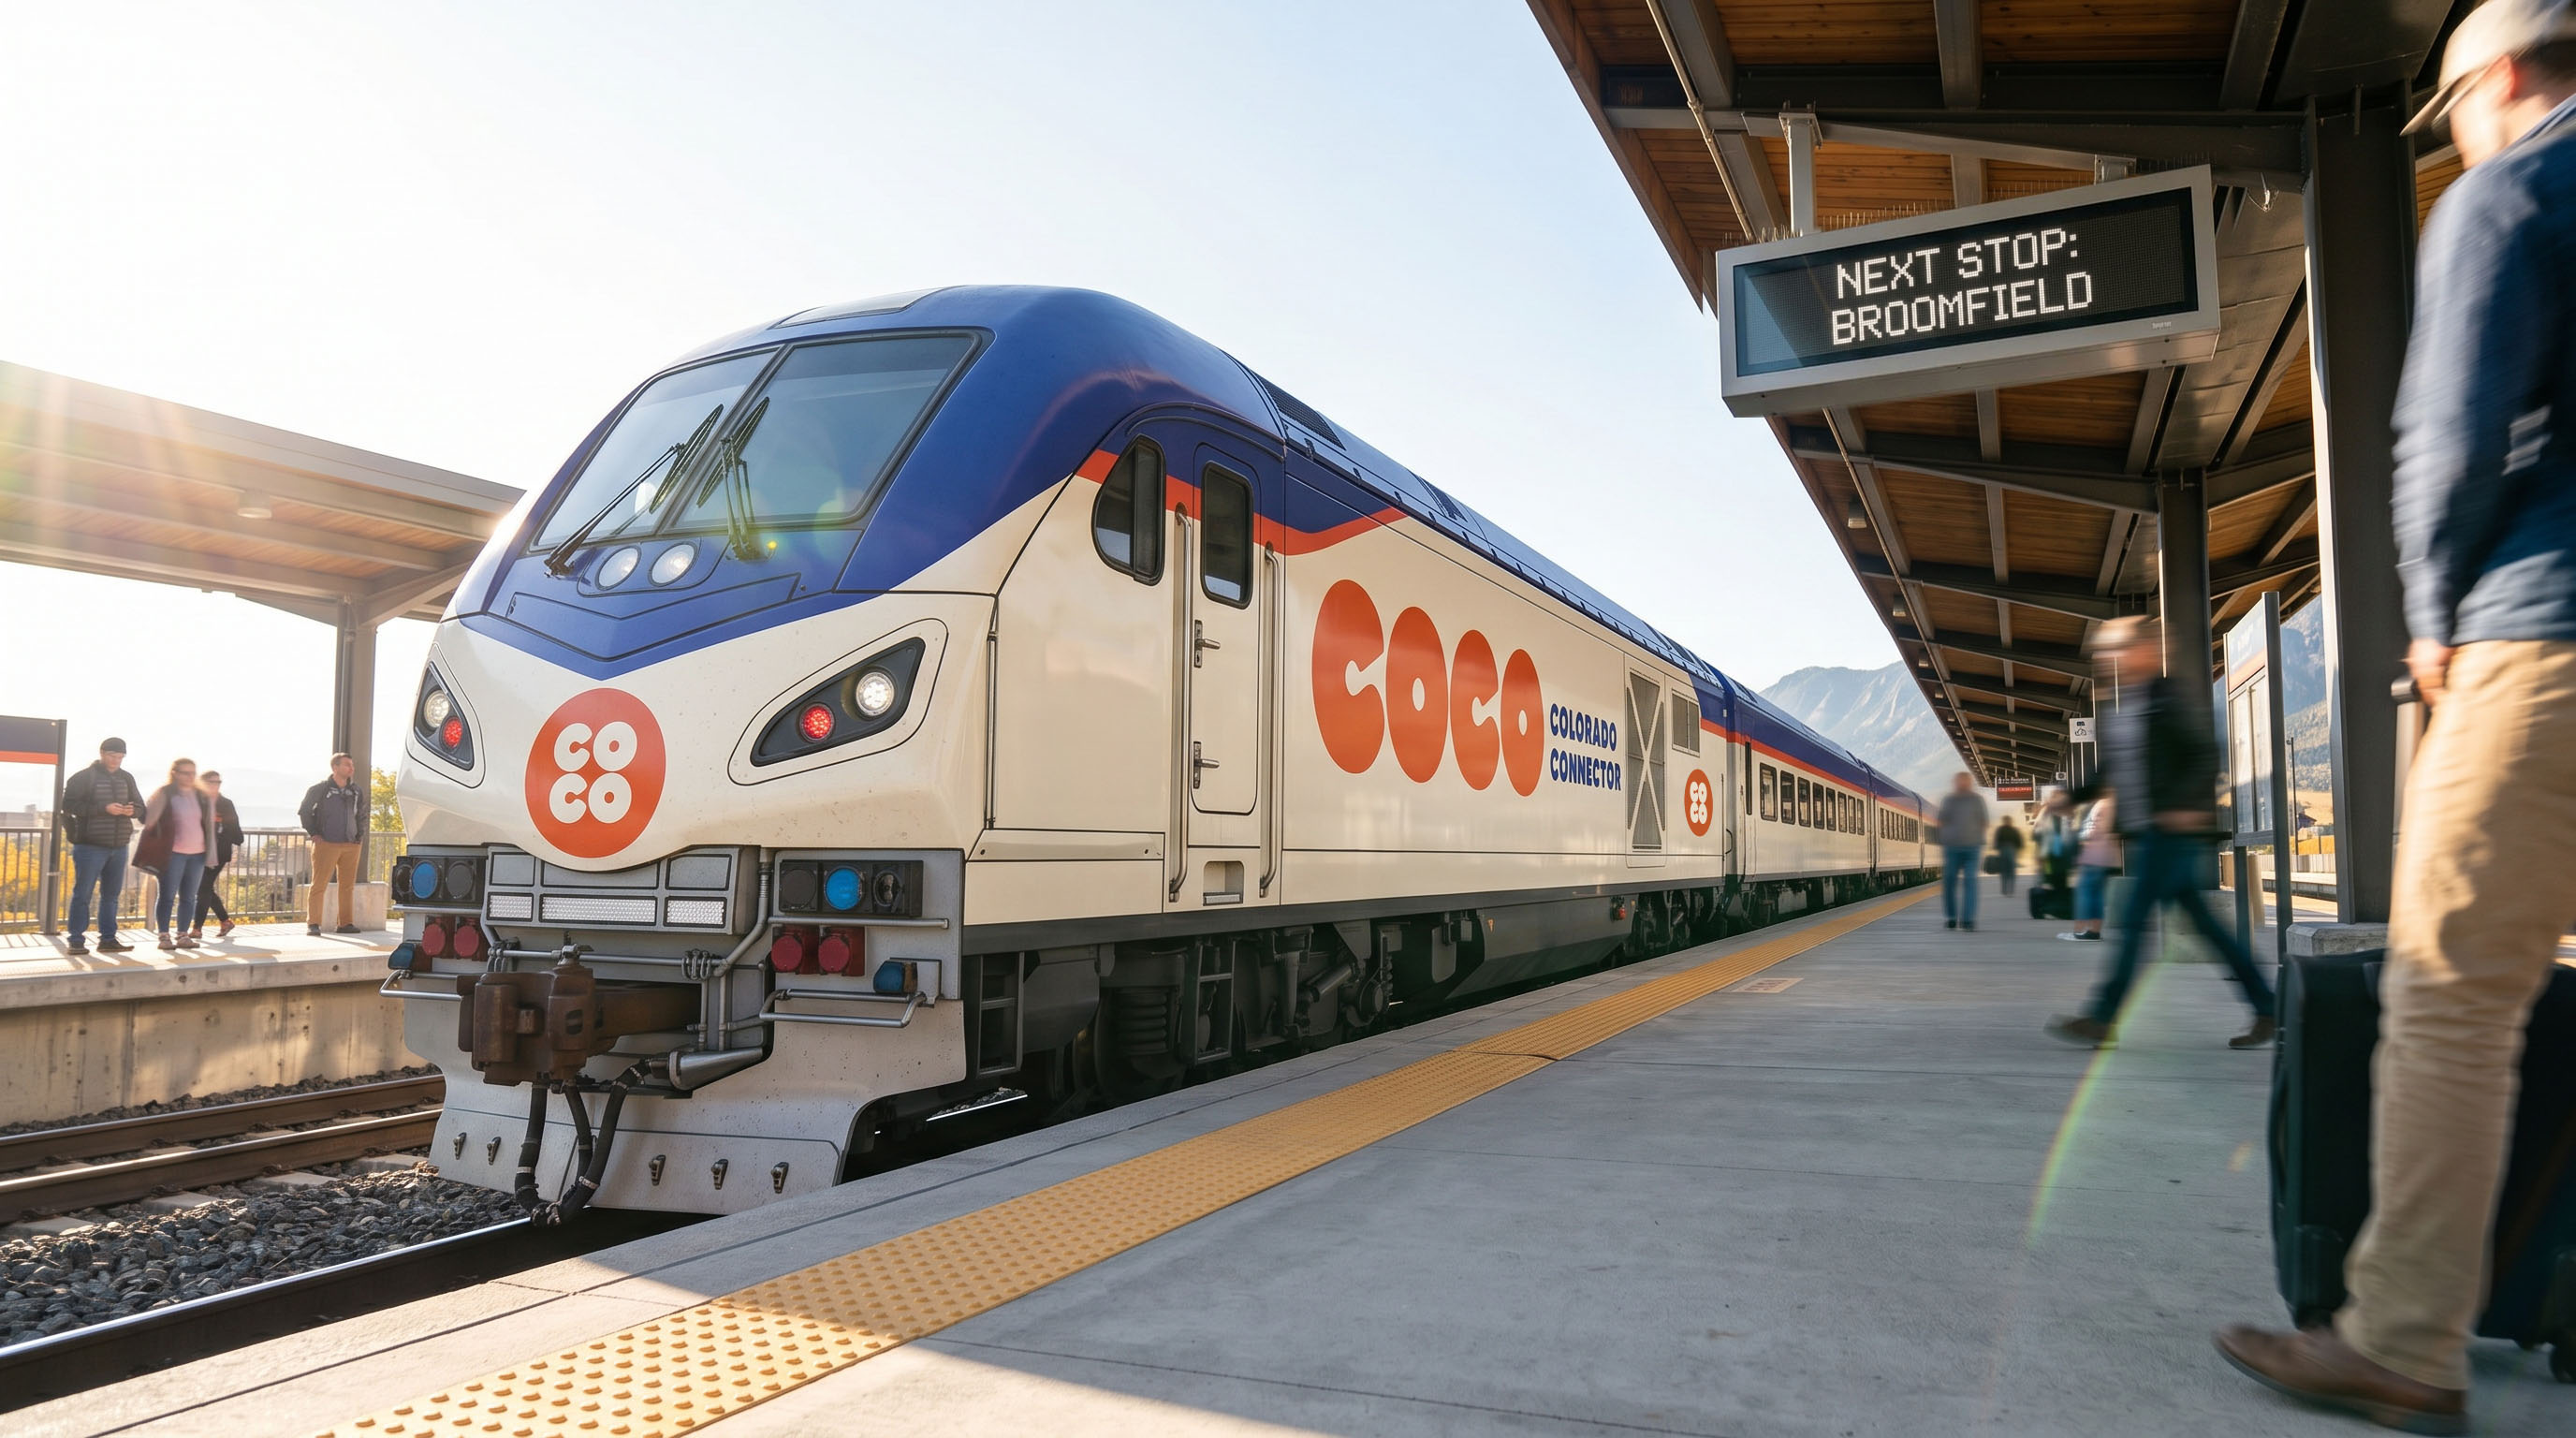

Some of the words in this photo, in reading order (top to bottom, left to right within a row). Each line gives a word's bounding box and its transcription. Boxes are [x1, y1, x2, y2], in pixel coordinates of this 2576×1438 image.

[1837, 247, 1940, 301] NEXT
[1957, 227, 2078, 279] STOP:
[1831, 271, 2093, 345] BROOMFIELD
[1311, 579, 1545, 798] COCO
[554, 721, 638, 772] CO
[1549, 703, 1617, 751] COLORADO
[1549, 747, 1621, 790] CONNECTOR
[549, 772, 633, 824] CO
